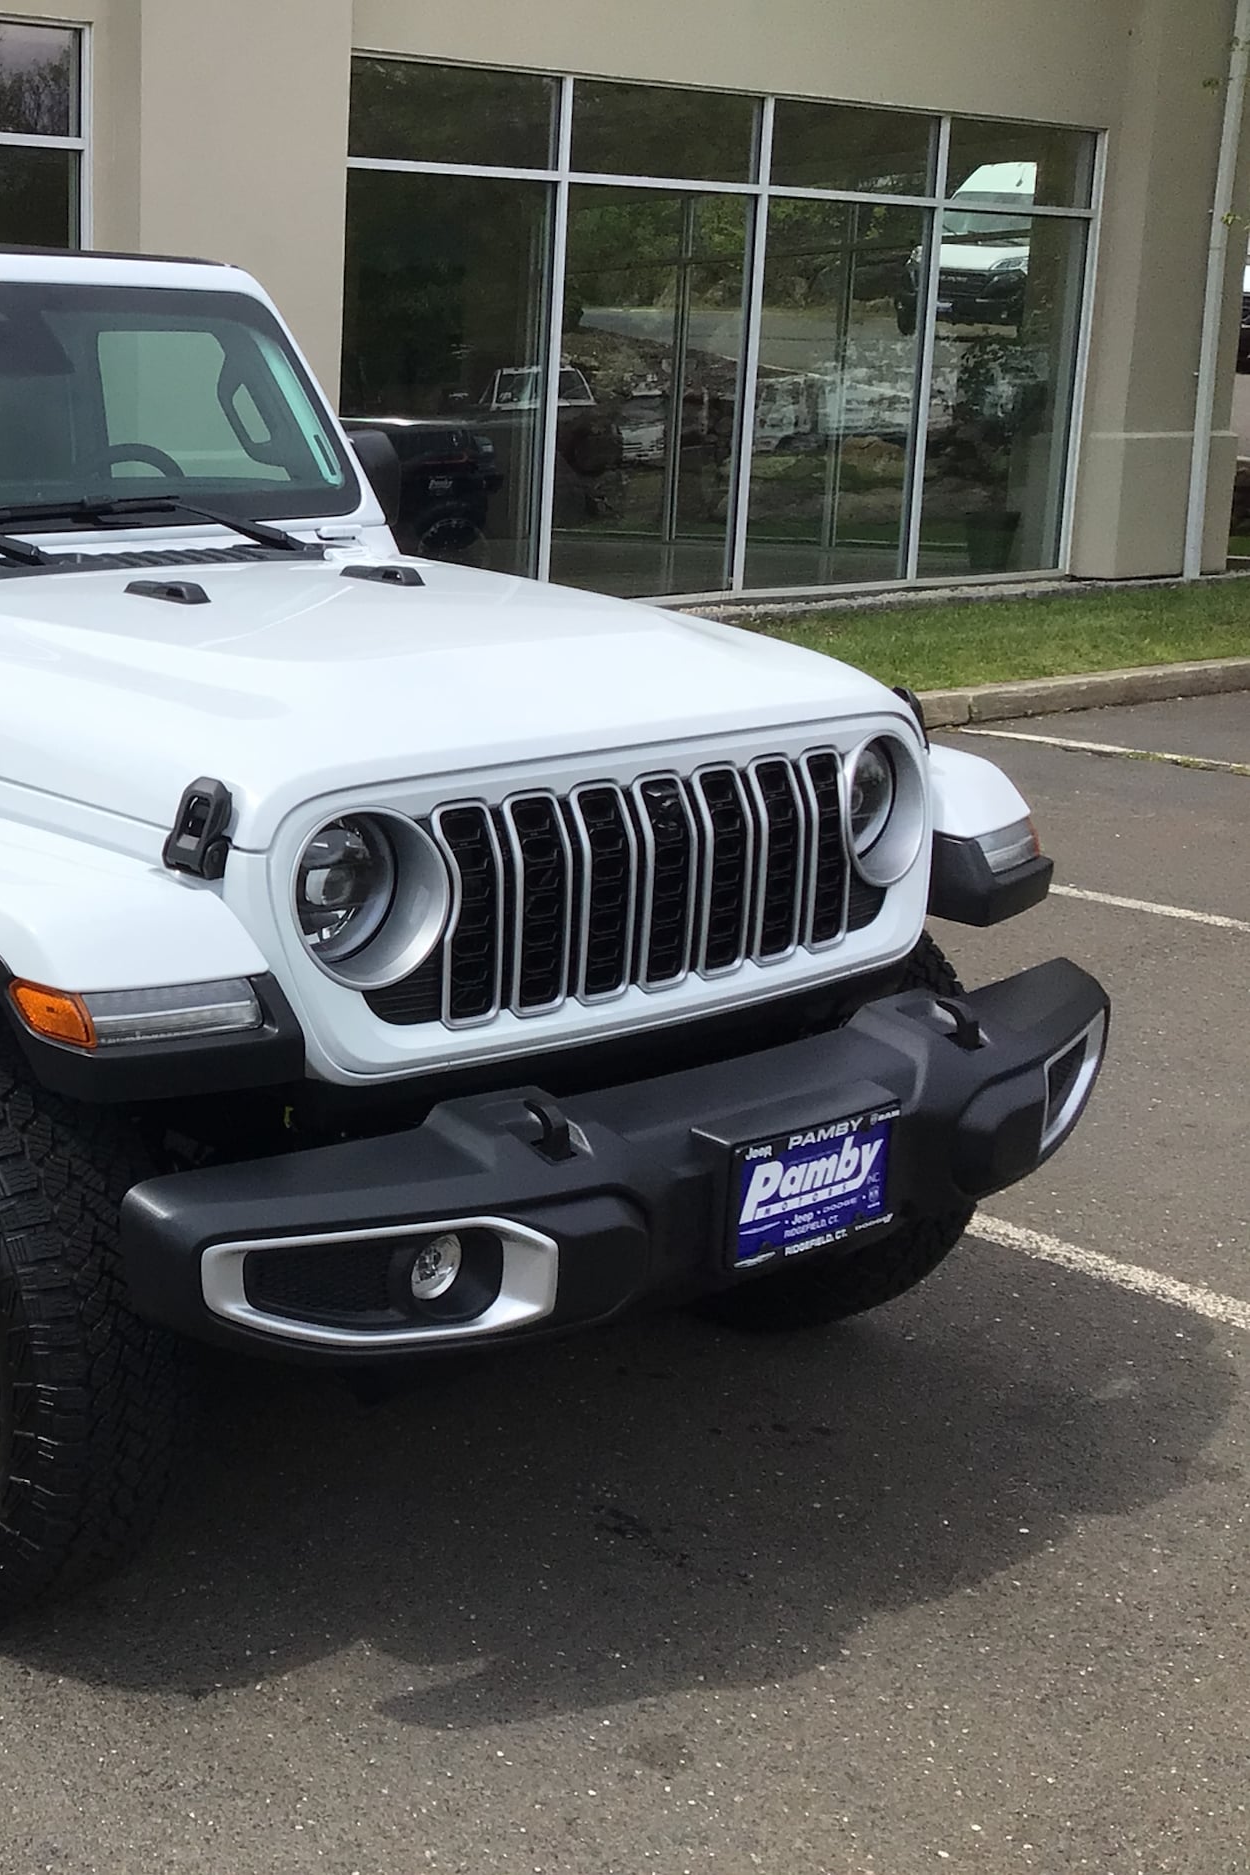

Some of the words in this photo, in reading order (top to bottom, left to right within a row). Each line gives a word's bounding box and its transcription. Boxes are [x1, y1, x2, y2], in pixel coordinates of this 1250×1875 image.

[787, 1116, 864, 1150] PAMBY
[744, 1144, 773, 1161] Jeep
[739, 1135, 885, 1225] Pamby
